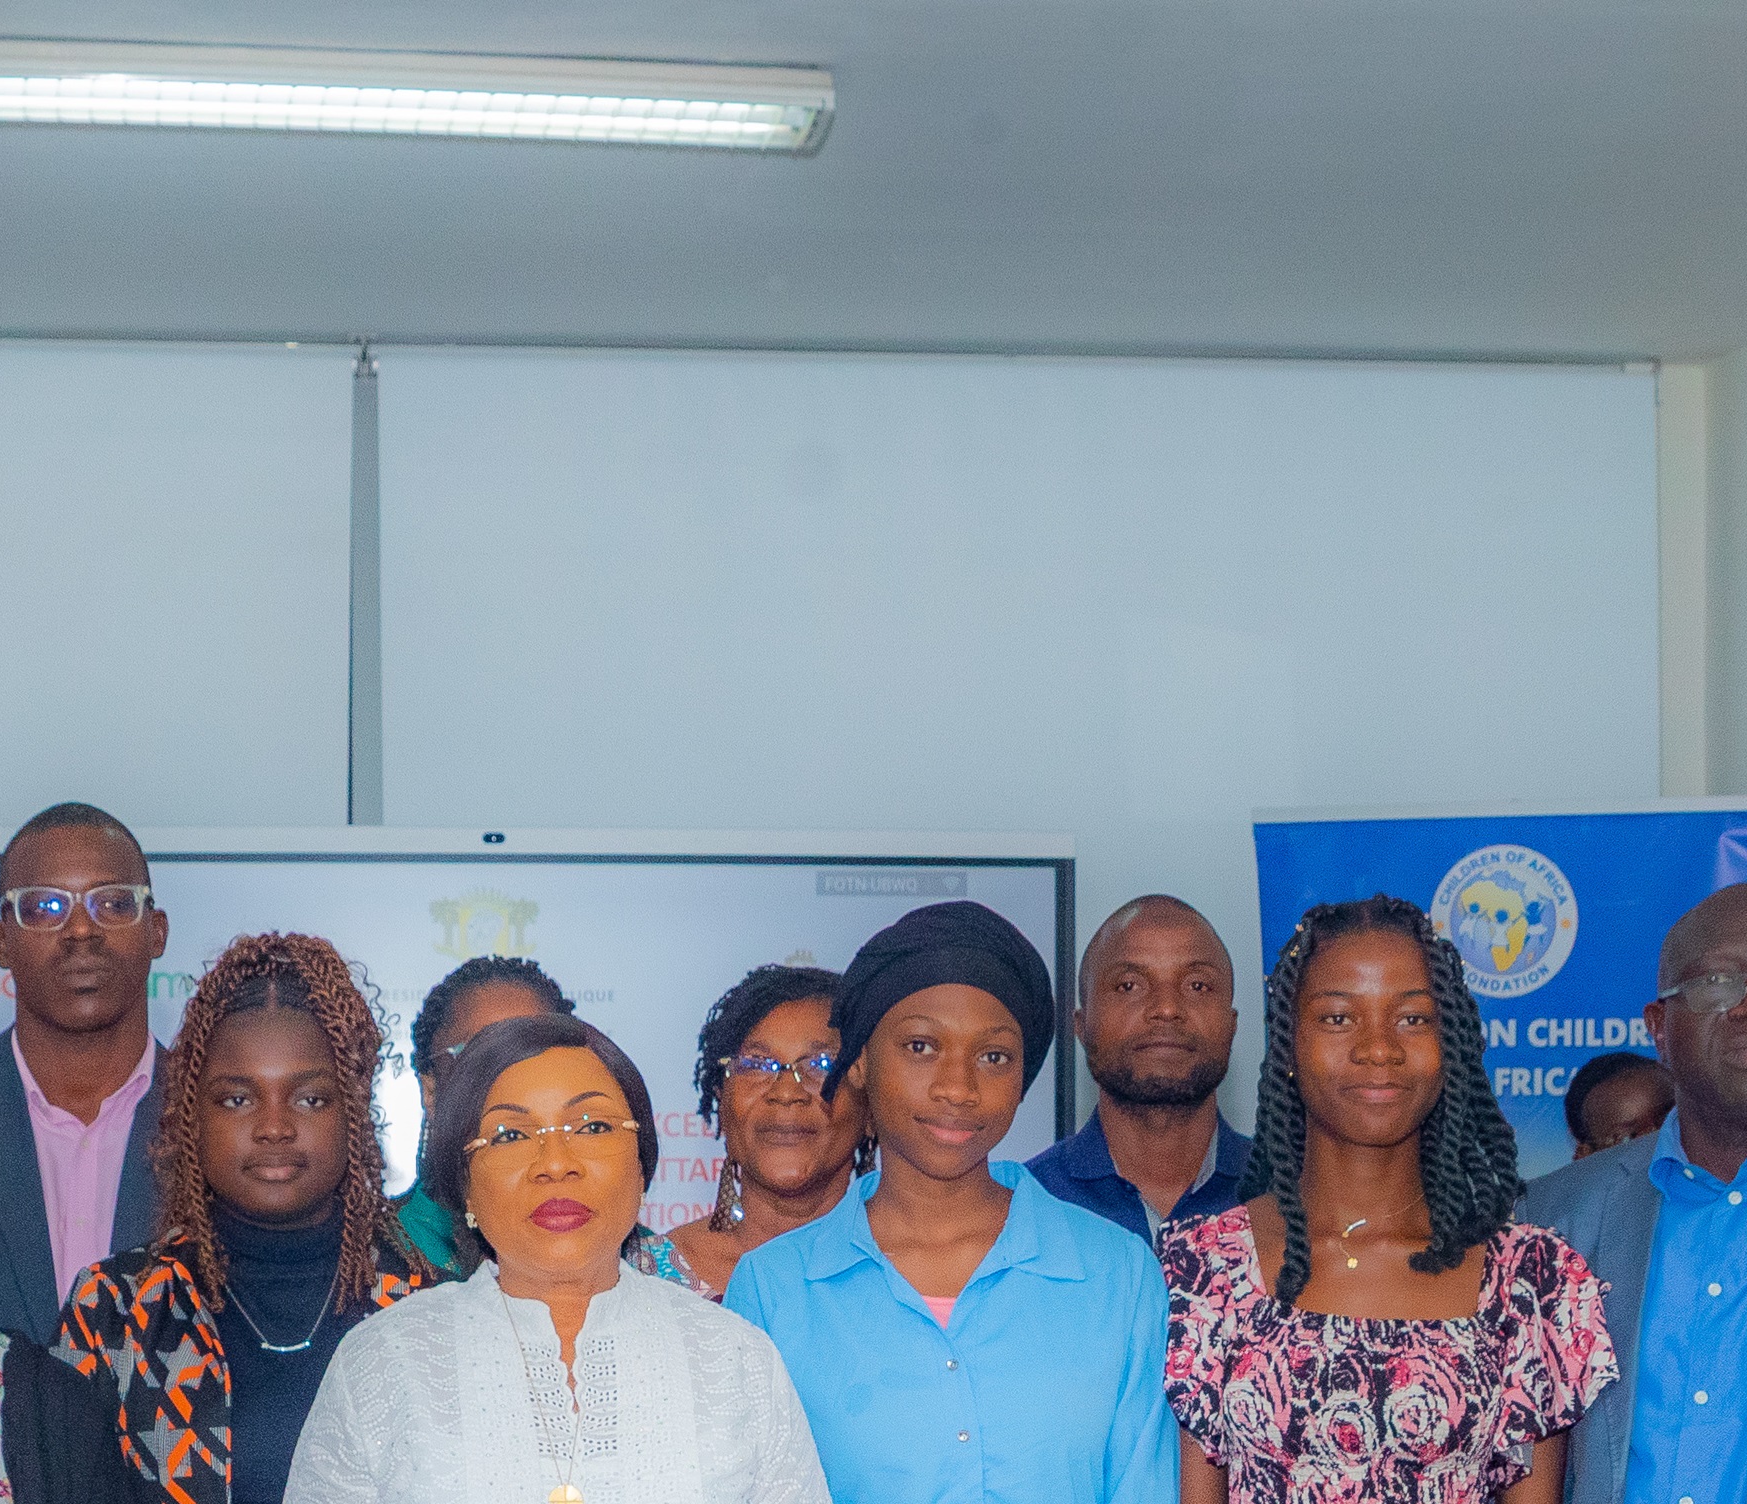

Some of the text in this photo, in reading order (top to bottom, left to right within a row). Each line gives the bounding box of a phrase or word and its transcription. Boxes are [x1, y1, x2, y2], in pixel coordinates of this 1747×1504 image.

[1439, 851, 1568, 906] CHILDREN OF AFRICA
[1465, 963, 1550, 992] ONDATION
[1527, 1017, 1655, 1048] CHILDR
[1495, 1066, 1579, 1097] FRIC
